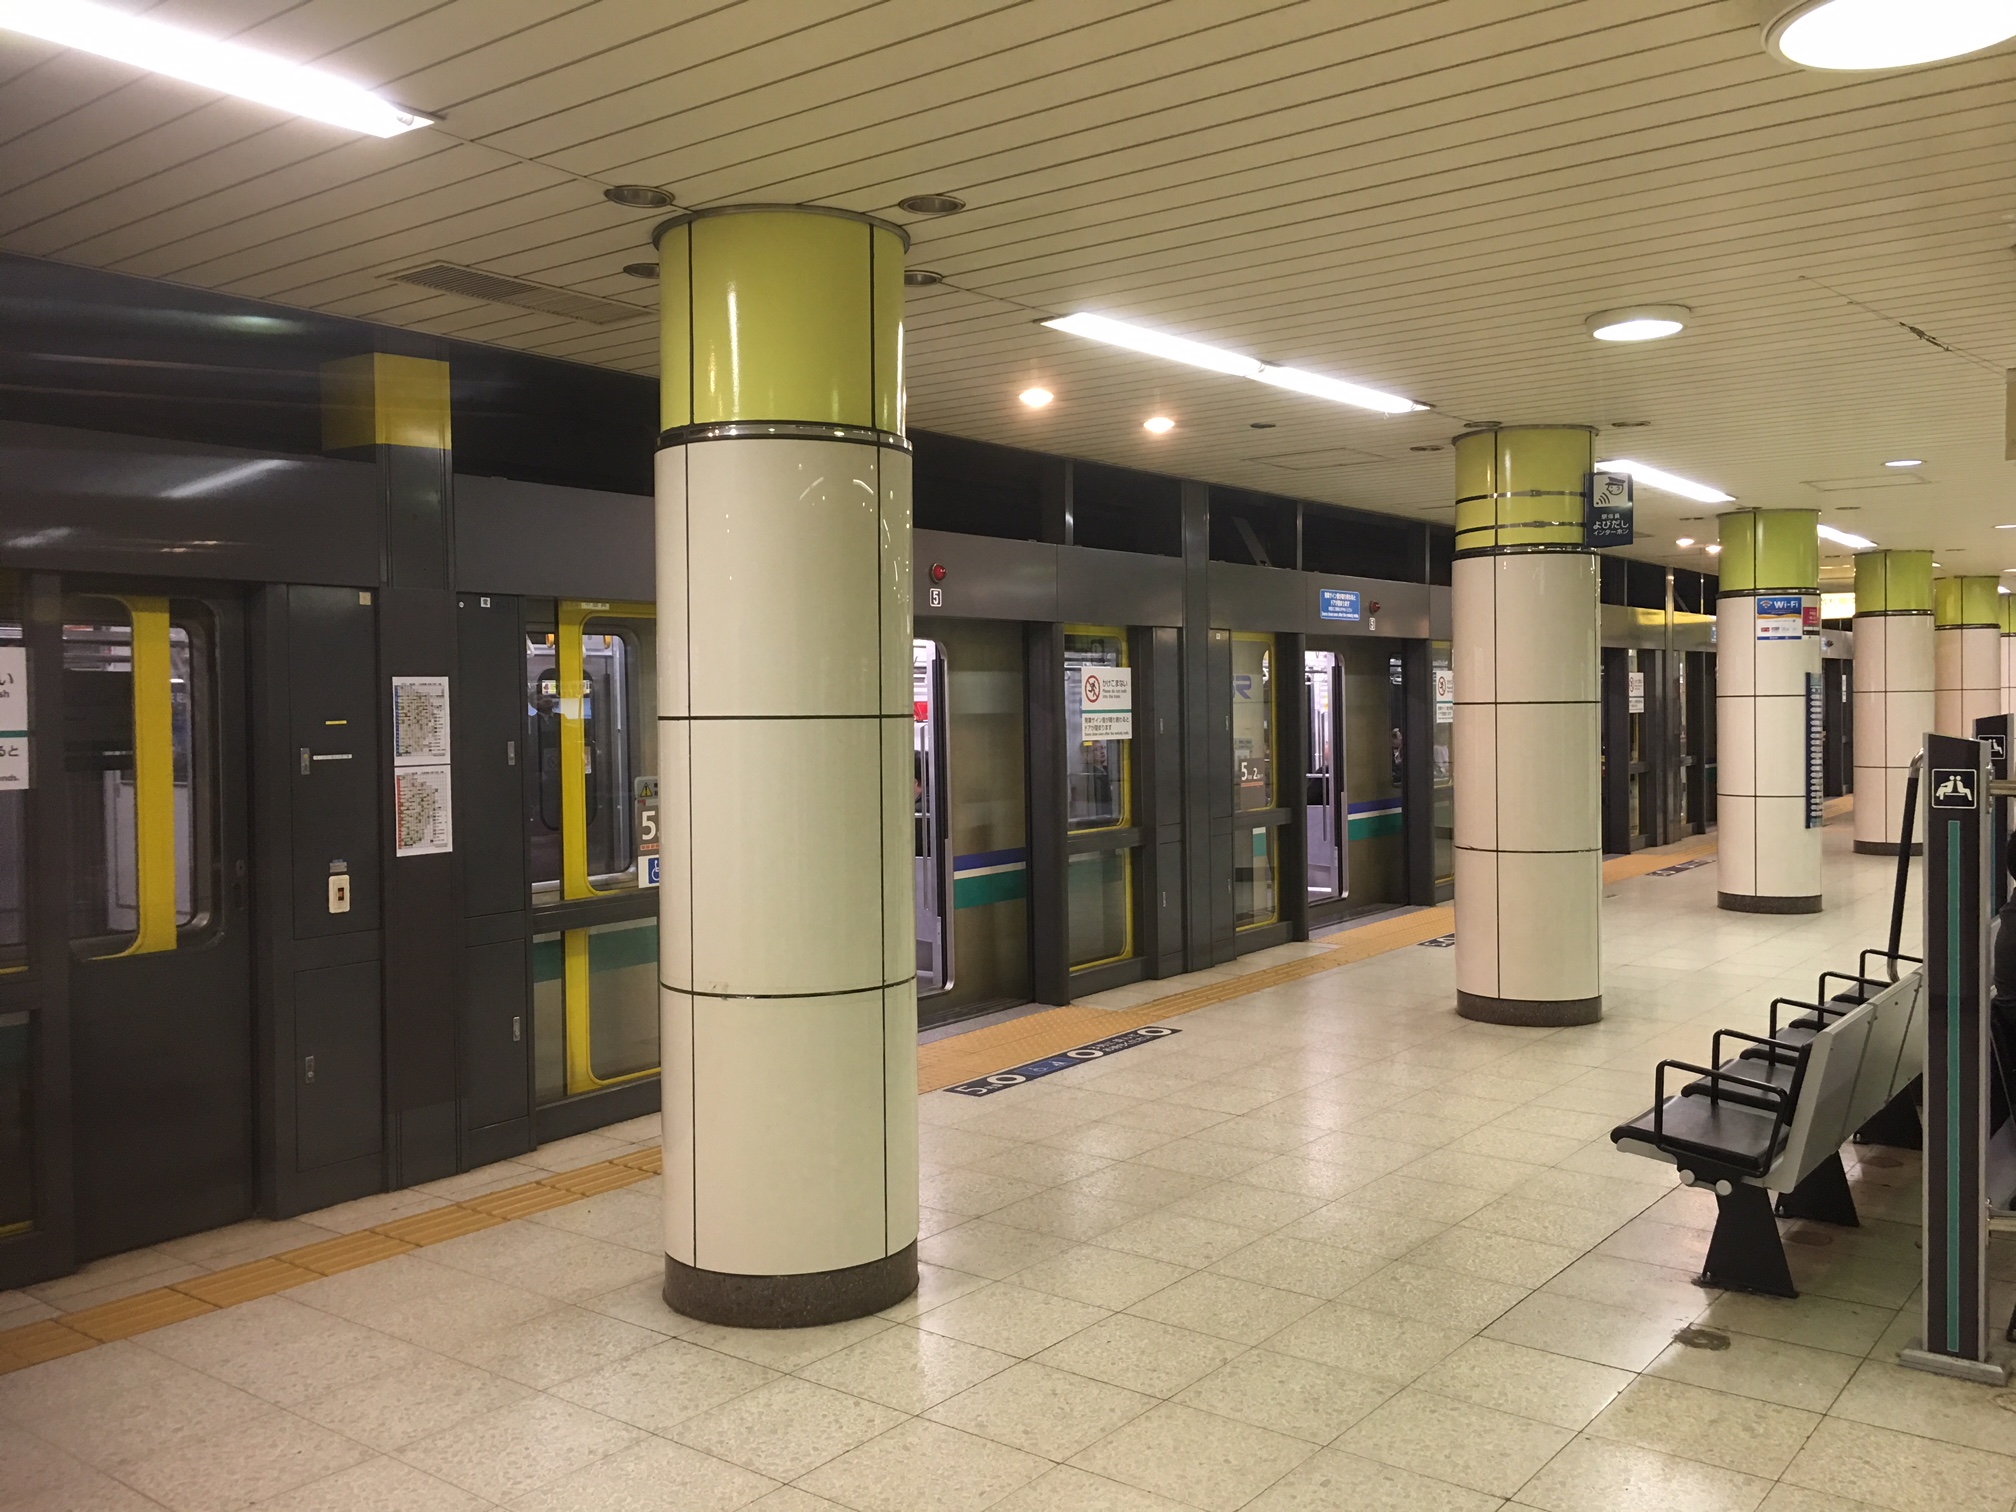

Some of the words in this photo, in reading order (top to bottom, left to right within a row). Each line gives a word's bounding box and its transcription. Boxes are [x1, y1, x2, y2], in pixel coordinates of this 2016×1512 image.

[1593, 520, 1629, 530] よびだし
[1774, 601, 1798, 609] Wi-Fi
[1102, 679, 1128, 688] かけこまない
[1233, 674, 1252, 699] R
[1241, 762, 1248, 781] 5
[1253, 767, 1258, 780] 2
[642, 811, 657, 840] 5
[954, 1085, 988, 1095] 5
